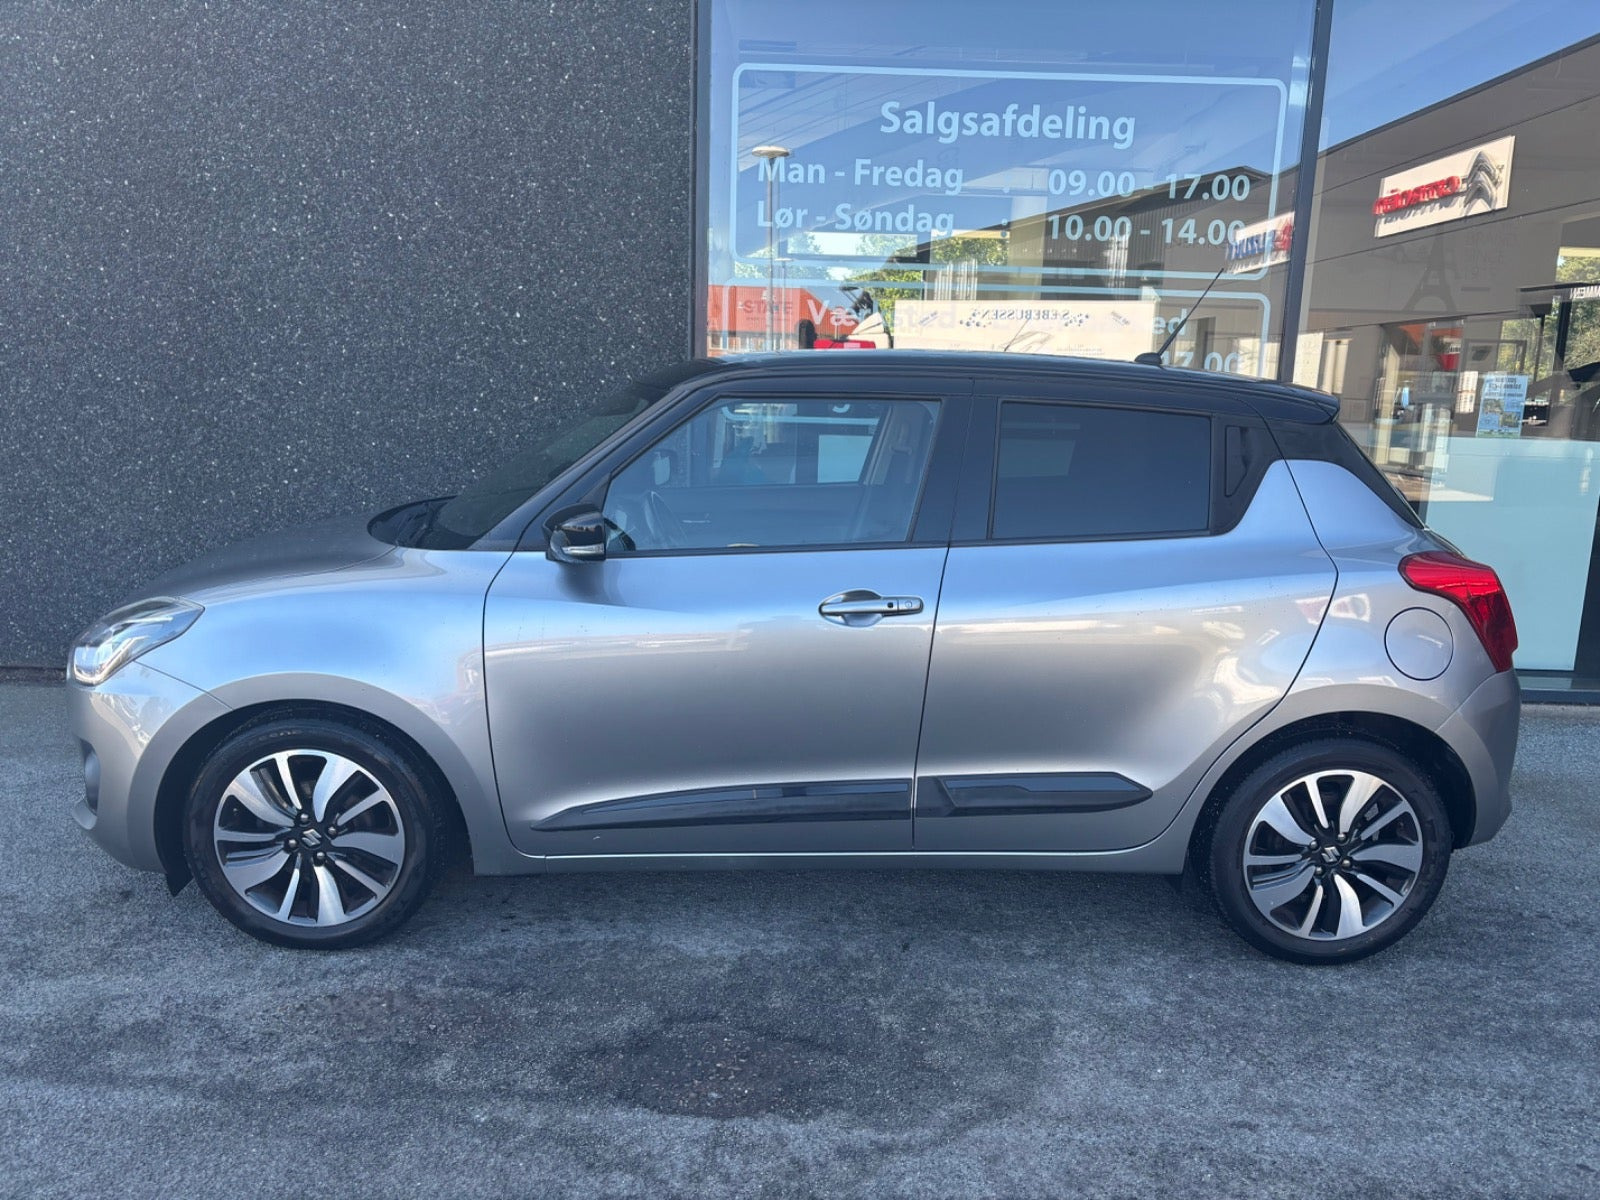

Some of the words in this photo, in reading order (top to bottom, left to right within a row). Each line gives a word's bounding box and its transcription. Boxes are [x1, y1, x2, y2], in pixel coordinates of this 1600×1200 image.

[880, 101, 1136, 150] Salgsafdeling
[757, 156, 825, 184] Man
[854, 158, 963, 196] Fredag
[1048, 169, 1135, 197] 09.00
[1165, 173, 1250, 201] 17.00
[757, 200, 808, 229] Lør
[834, 203, 954, 237] Søndag
[1049, 214, 1132, 242] 10.00
[1161, 218, 1245, 246] 14.00
